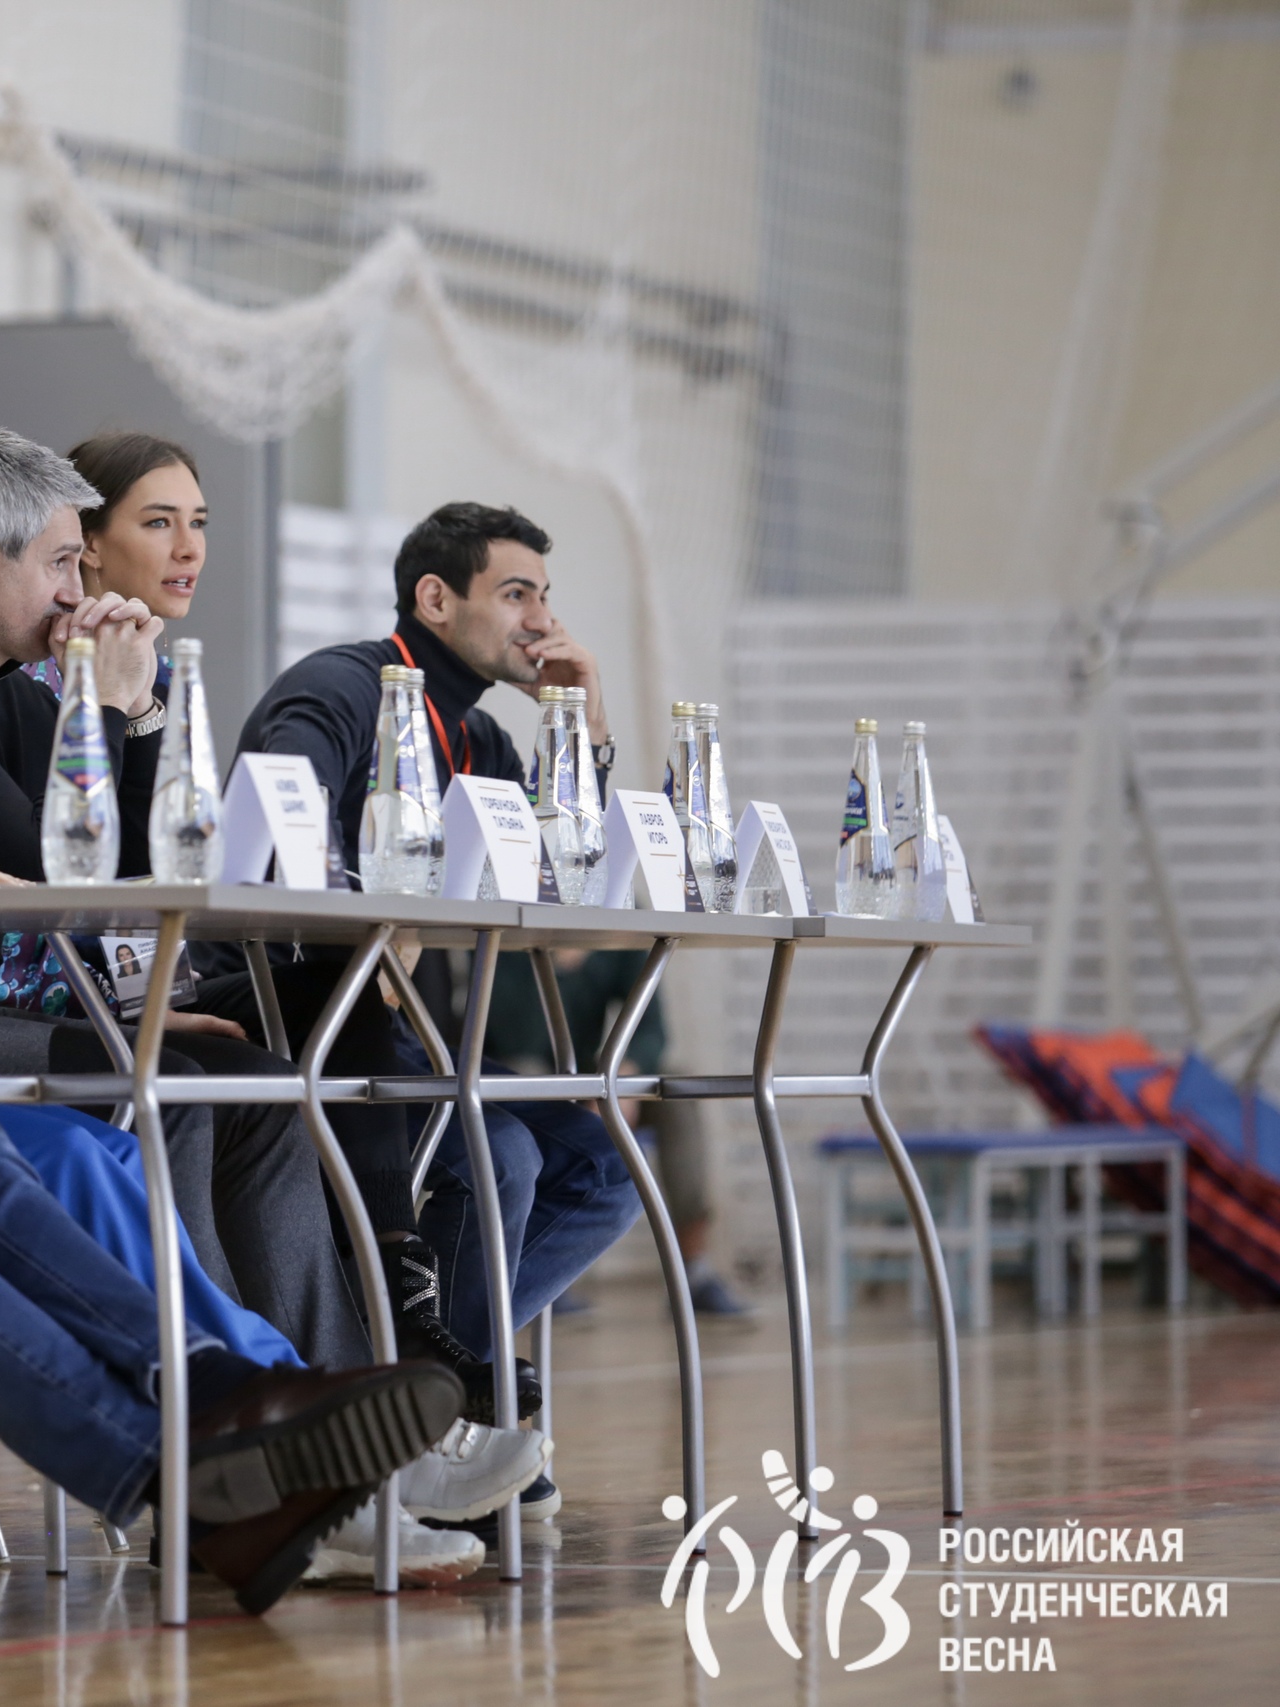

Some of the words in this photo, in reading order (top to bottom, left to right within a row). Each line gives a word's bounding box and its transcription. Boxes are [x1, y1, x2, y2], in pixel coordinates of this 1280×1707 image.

[492, 815, 526, 831] ТАТЬЯНА
[639, 812, 665, 826] ЛАВРОВ
[647, 831, 668, 845] ИГОРЬ
